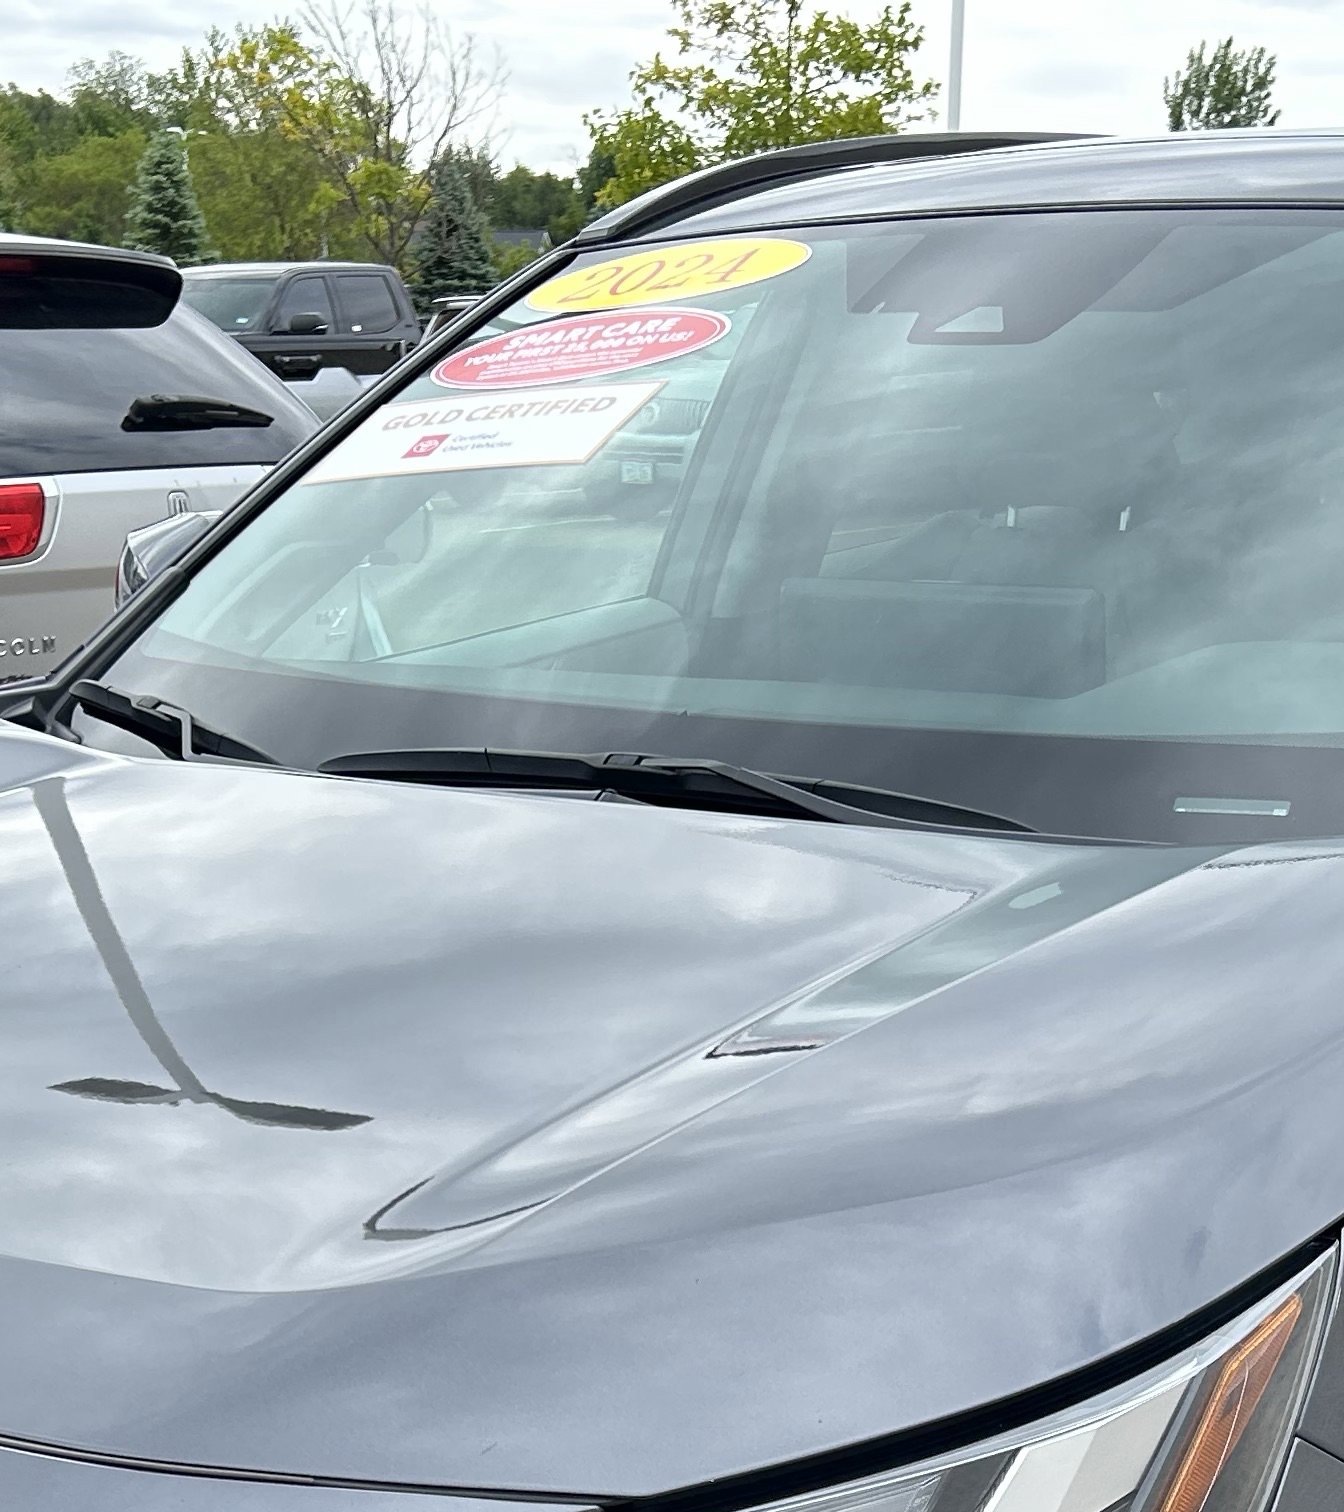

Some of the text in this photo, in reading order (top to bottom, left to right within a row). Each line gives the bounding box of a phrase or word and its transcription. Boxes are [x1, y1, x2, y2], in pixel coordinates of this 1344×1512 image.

[556, 247, 760, 303] 2024
[502, 316, 682, 351] SMART CARE
[512, 343, 566, 359] FIRST
[625, 333, 660, 346] ON
[381, 396, 618, 431] GOLD CERTIFIED
